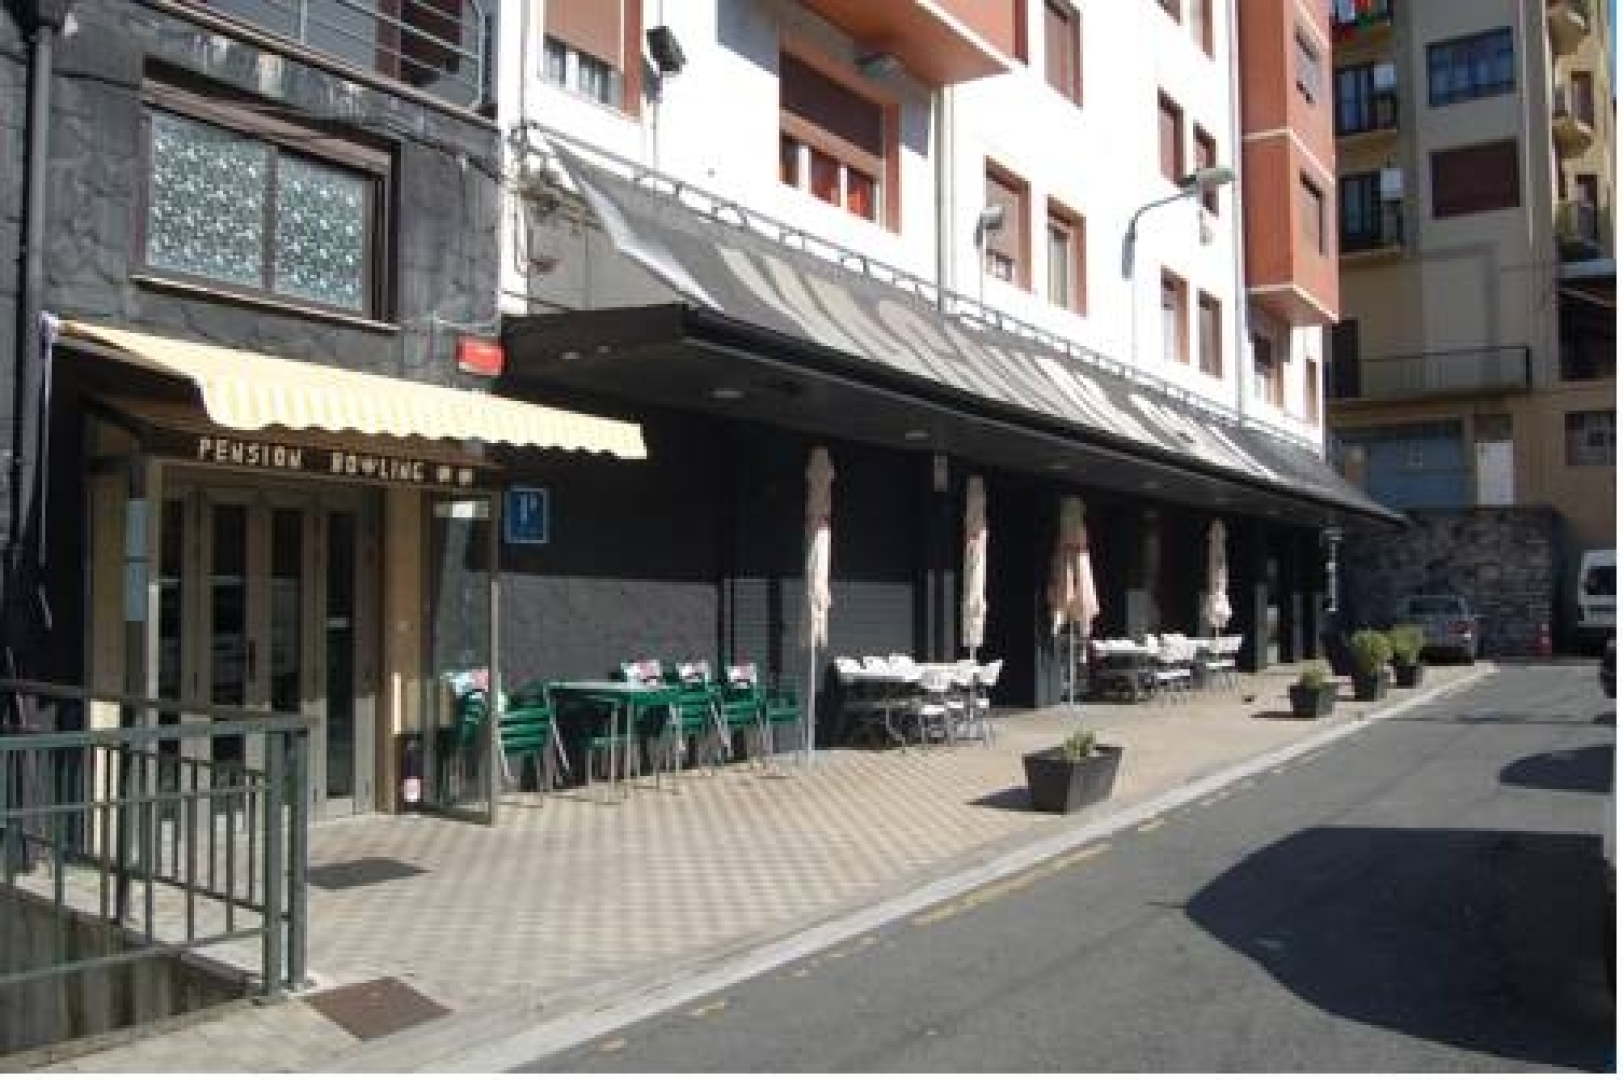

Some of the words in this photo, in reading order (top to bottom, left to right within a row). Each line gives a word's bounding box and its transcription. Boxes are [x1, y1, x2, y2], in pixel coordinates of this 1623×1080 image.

[199, 438, 302, 470] PENSION
[331, 451, 425, 483] BOWLING
[519, 493, 538, 525] P
